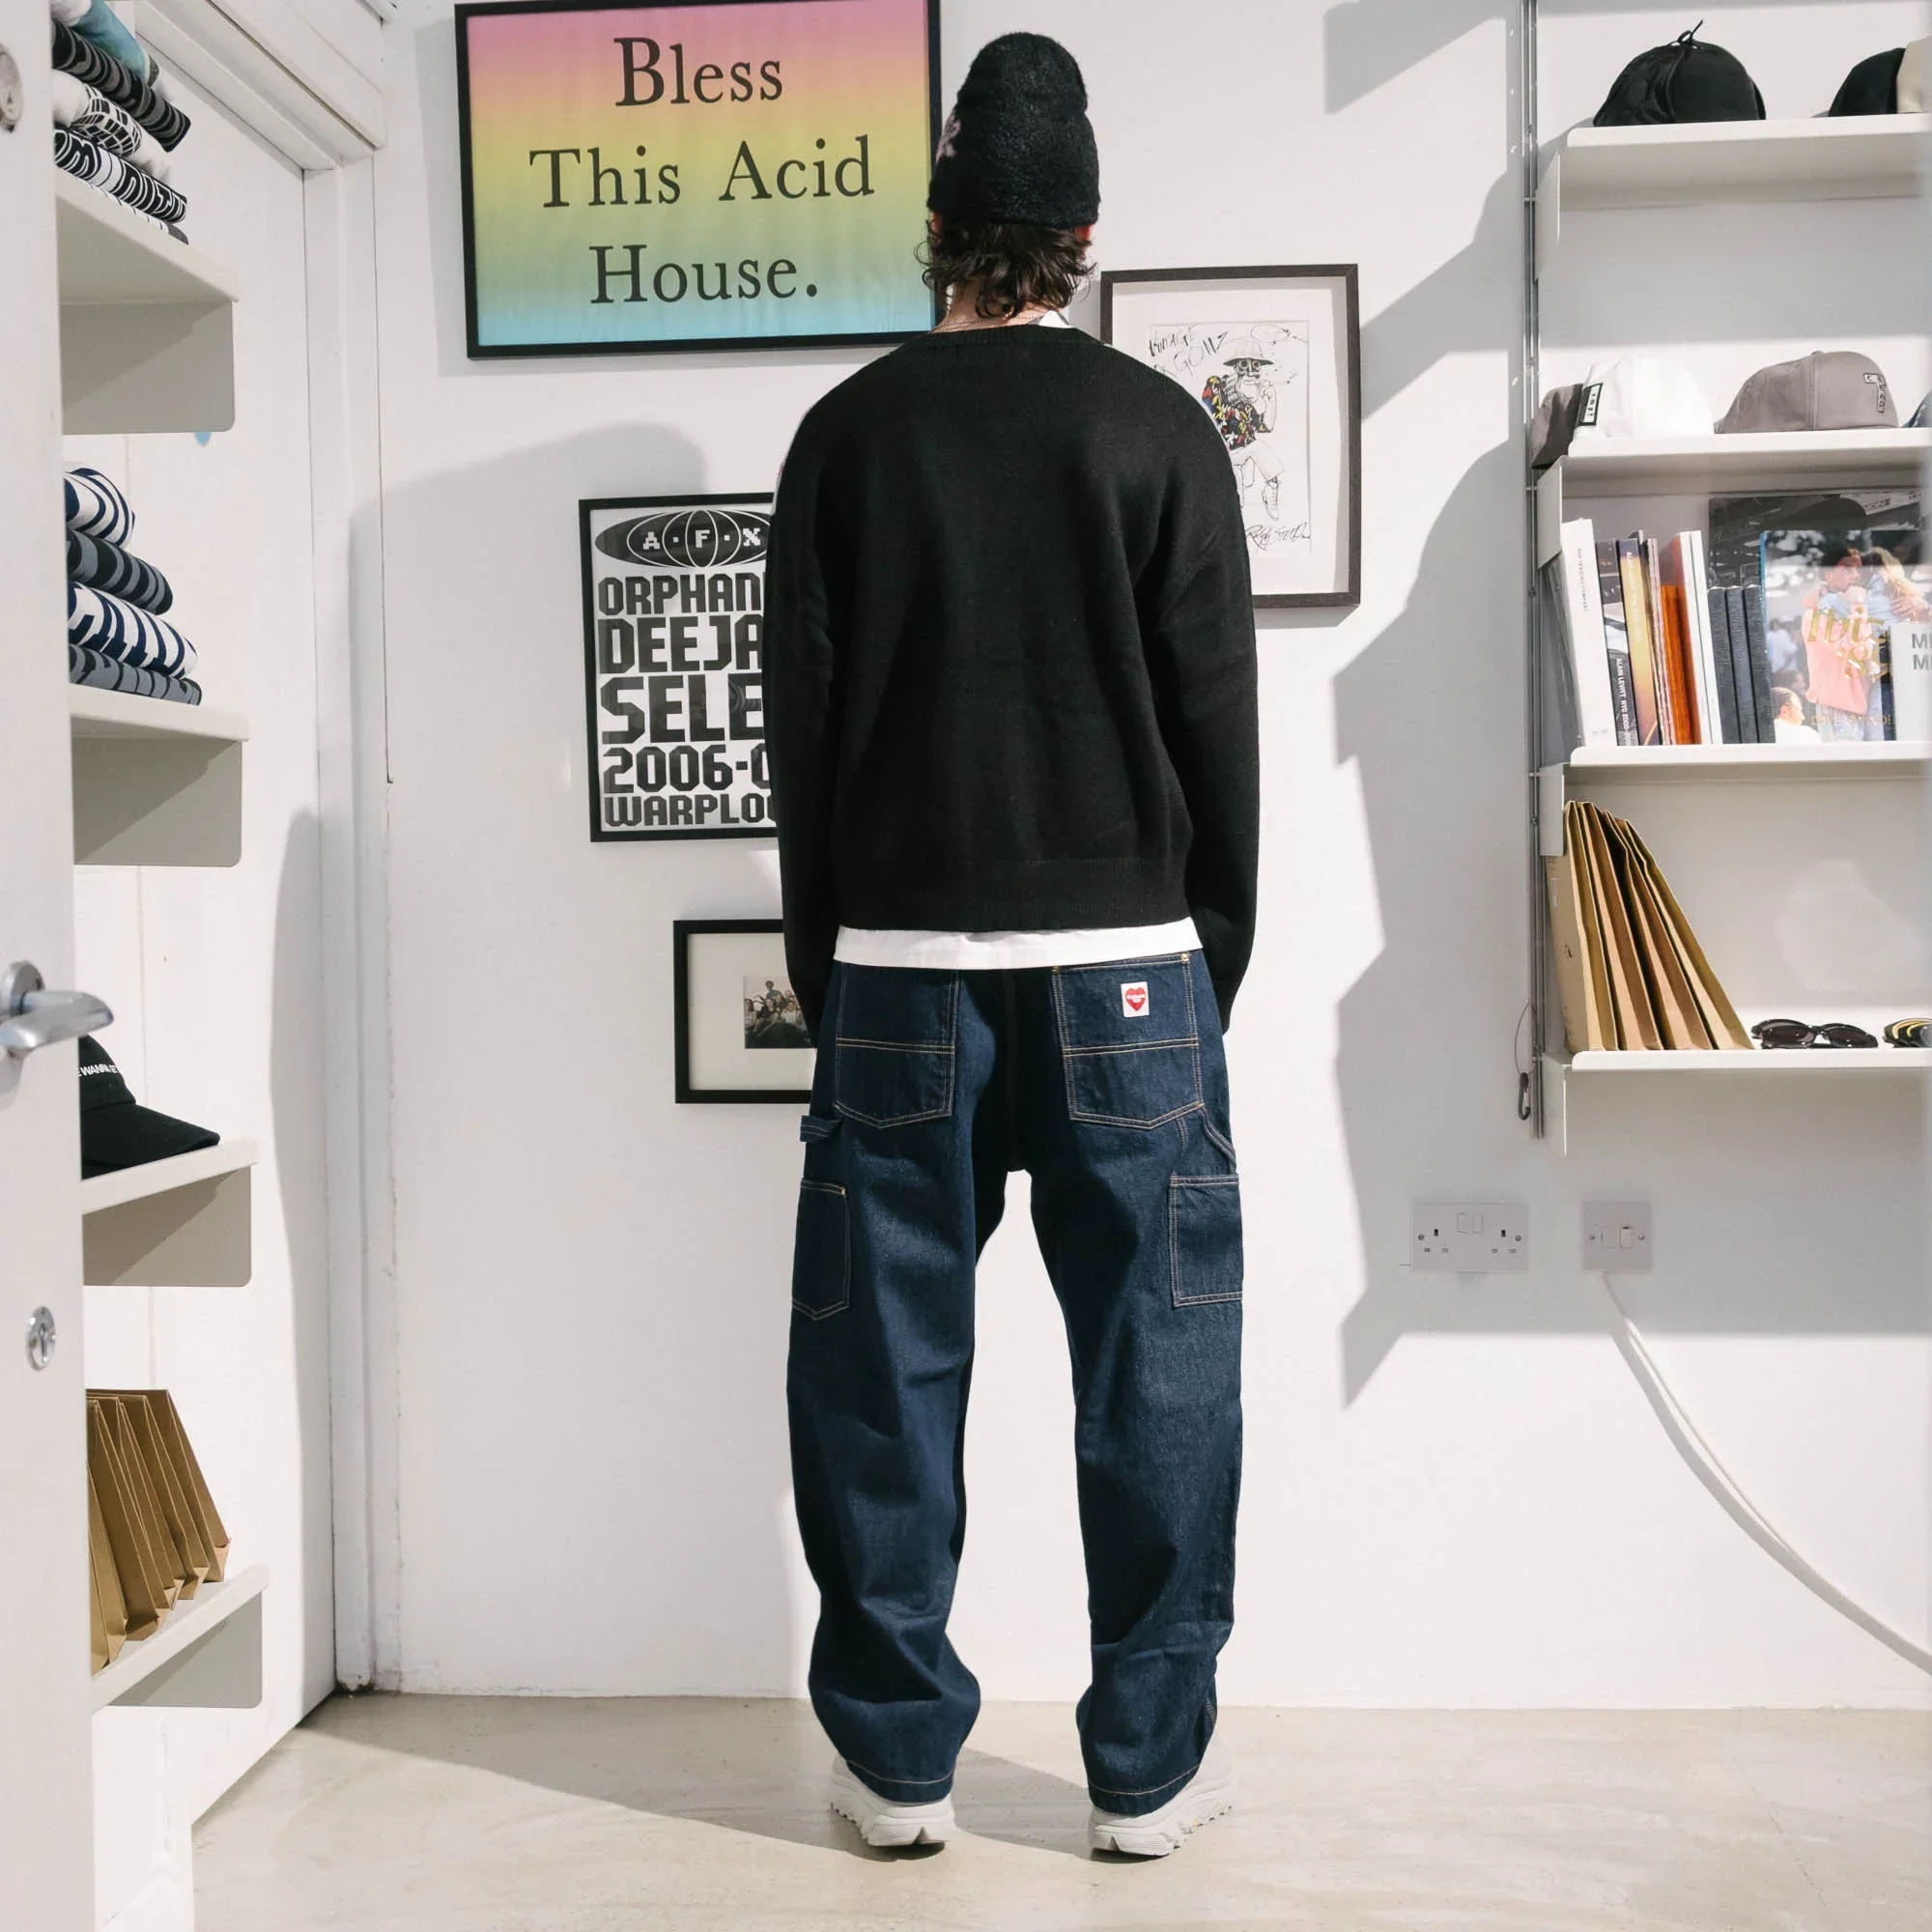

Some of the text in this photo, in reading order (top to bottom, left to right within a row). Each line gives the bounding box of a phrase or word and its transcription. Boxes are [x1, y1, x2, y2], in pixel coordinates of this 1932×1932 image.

[613, 37, 783, 106] Bless
[529, 134, 874, 208] This Acid
[589, 243, 818, 304] House.
[598, 572, 766, 616] ORPHAN
[598, 613, 763, 674] DEEJA
[600, 672, 765, 745] SELE
[603, 743, 771, 794] 2006-0
[604, 792, 775, 828] WARPLO
